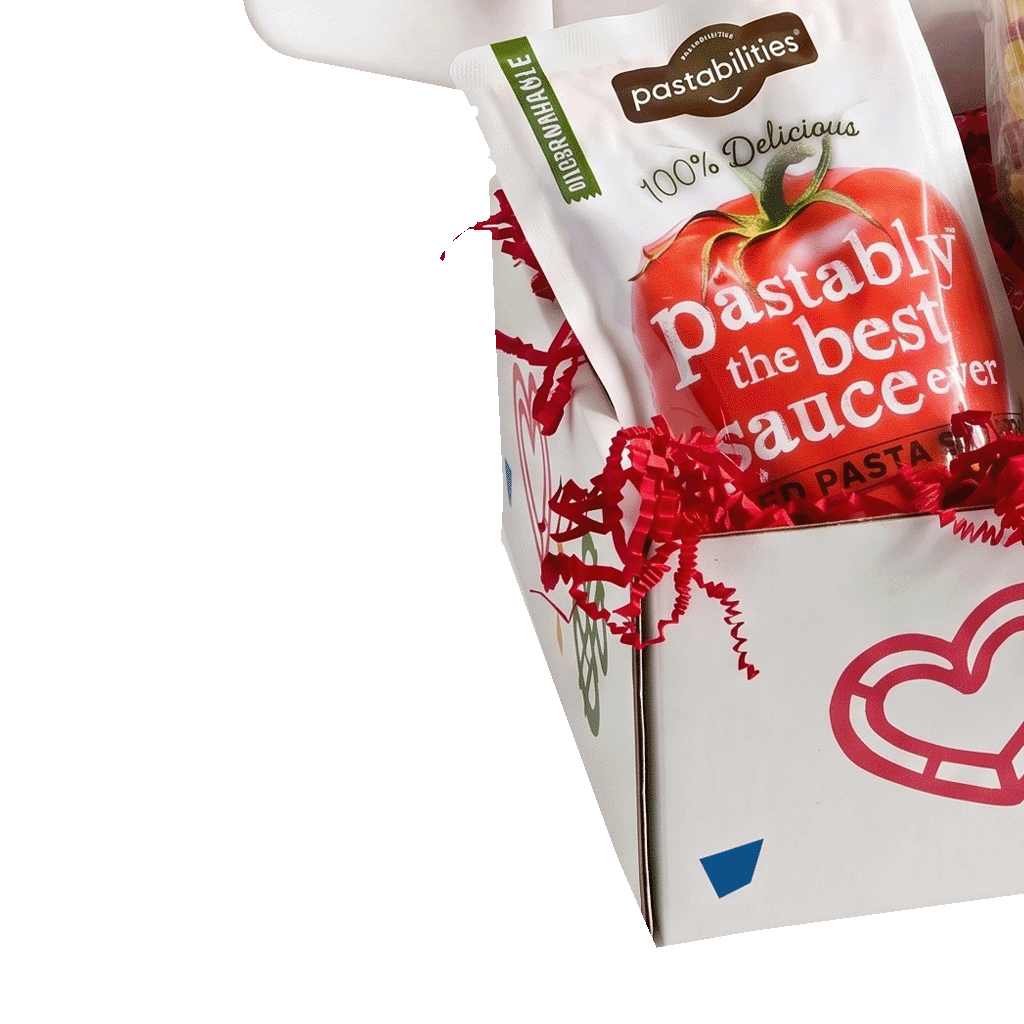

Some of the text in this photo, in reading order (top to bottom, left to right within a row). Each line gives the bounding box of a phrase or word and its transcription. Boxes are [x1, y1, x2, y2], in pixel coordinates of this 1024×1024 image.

[640, 120, 860, 203] 100% Delicious
[726, 291, 953, 389] the best
[715, 369, 925, 471] sauce
[927, 359, 998, 394] ever
[815, 440, 934, 497] PASTA
